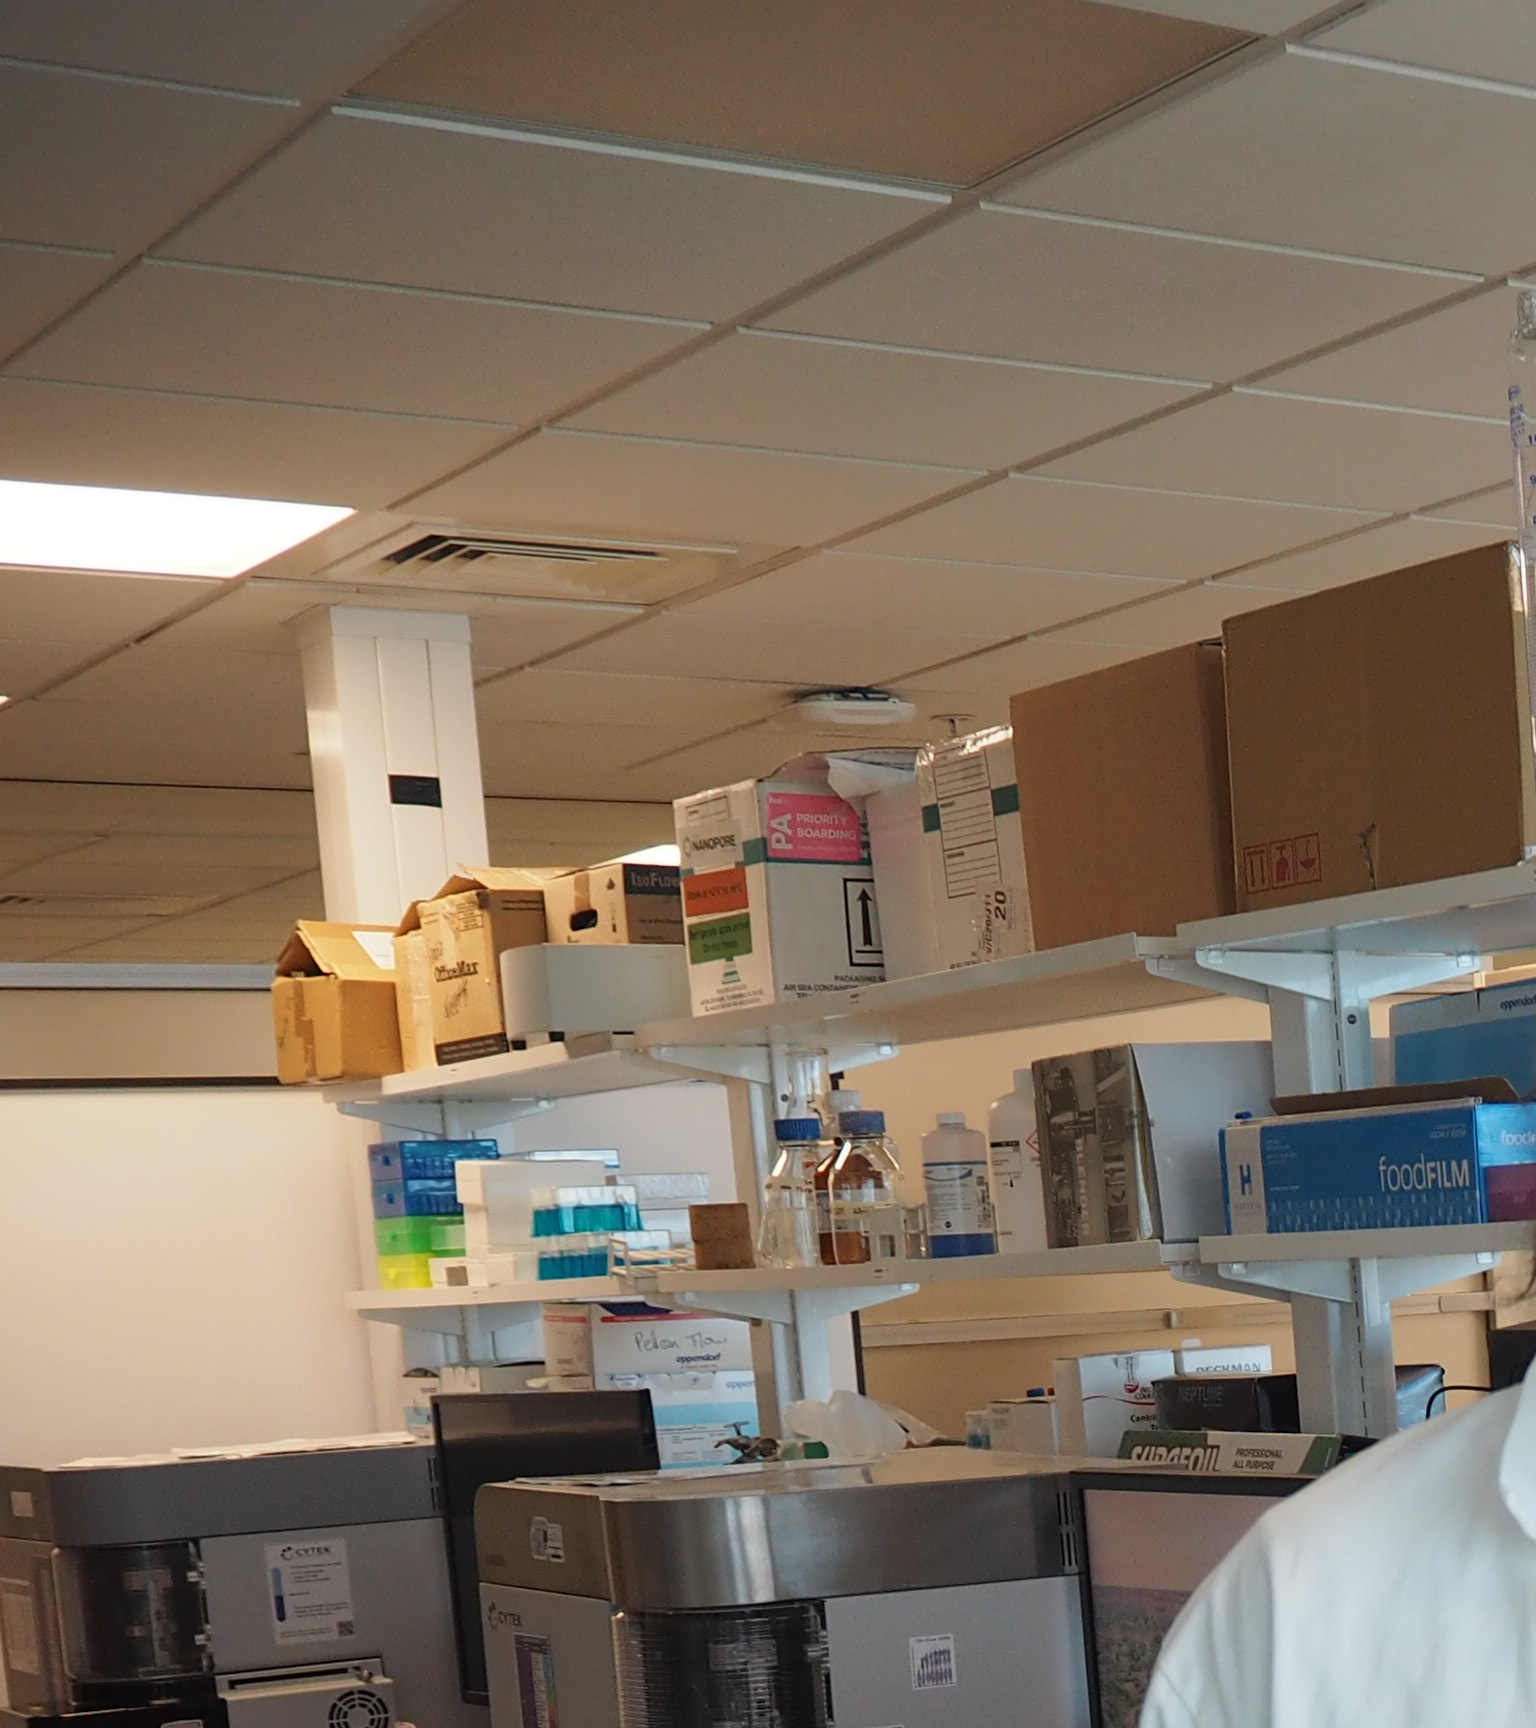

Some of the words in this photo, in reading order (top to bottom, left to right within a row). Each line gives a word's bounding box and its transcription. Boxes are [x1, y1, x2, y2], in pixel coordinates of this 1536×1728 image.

[795, 812, 848, 825] PRIORITY
[770, 813, 793, 850] PA
[796, 827, 857, 841] BOARDING
[691, 833, 737, 852] NANOPORE
[994, 889, 1007, 921] 20
[834, 974, 877, 983] PACKAGING
[797, 983, 812, 992] SEA
[1378, 1153, 1470, 1193] foodFILM
[1074, 1138, 1090, 1237] BLENDER
[675, 1352, 721, 1365] eppendorf
[725, 1378, 755, 1392] eppen
[1177, 1386, 1223, 1402] NEPTUNE
[1234, 1447, 1283, 1459] PROFESSIONAL
[1232, 1459, 1248, 1469] ALL
[1248, 1459, 1275, 1470] PURPOSE
[295, 1546, 330, 1557] CYTEK
